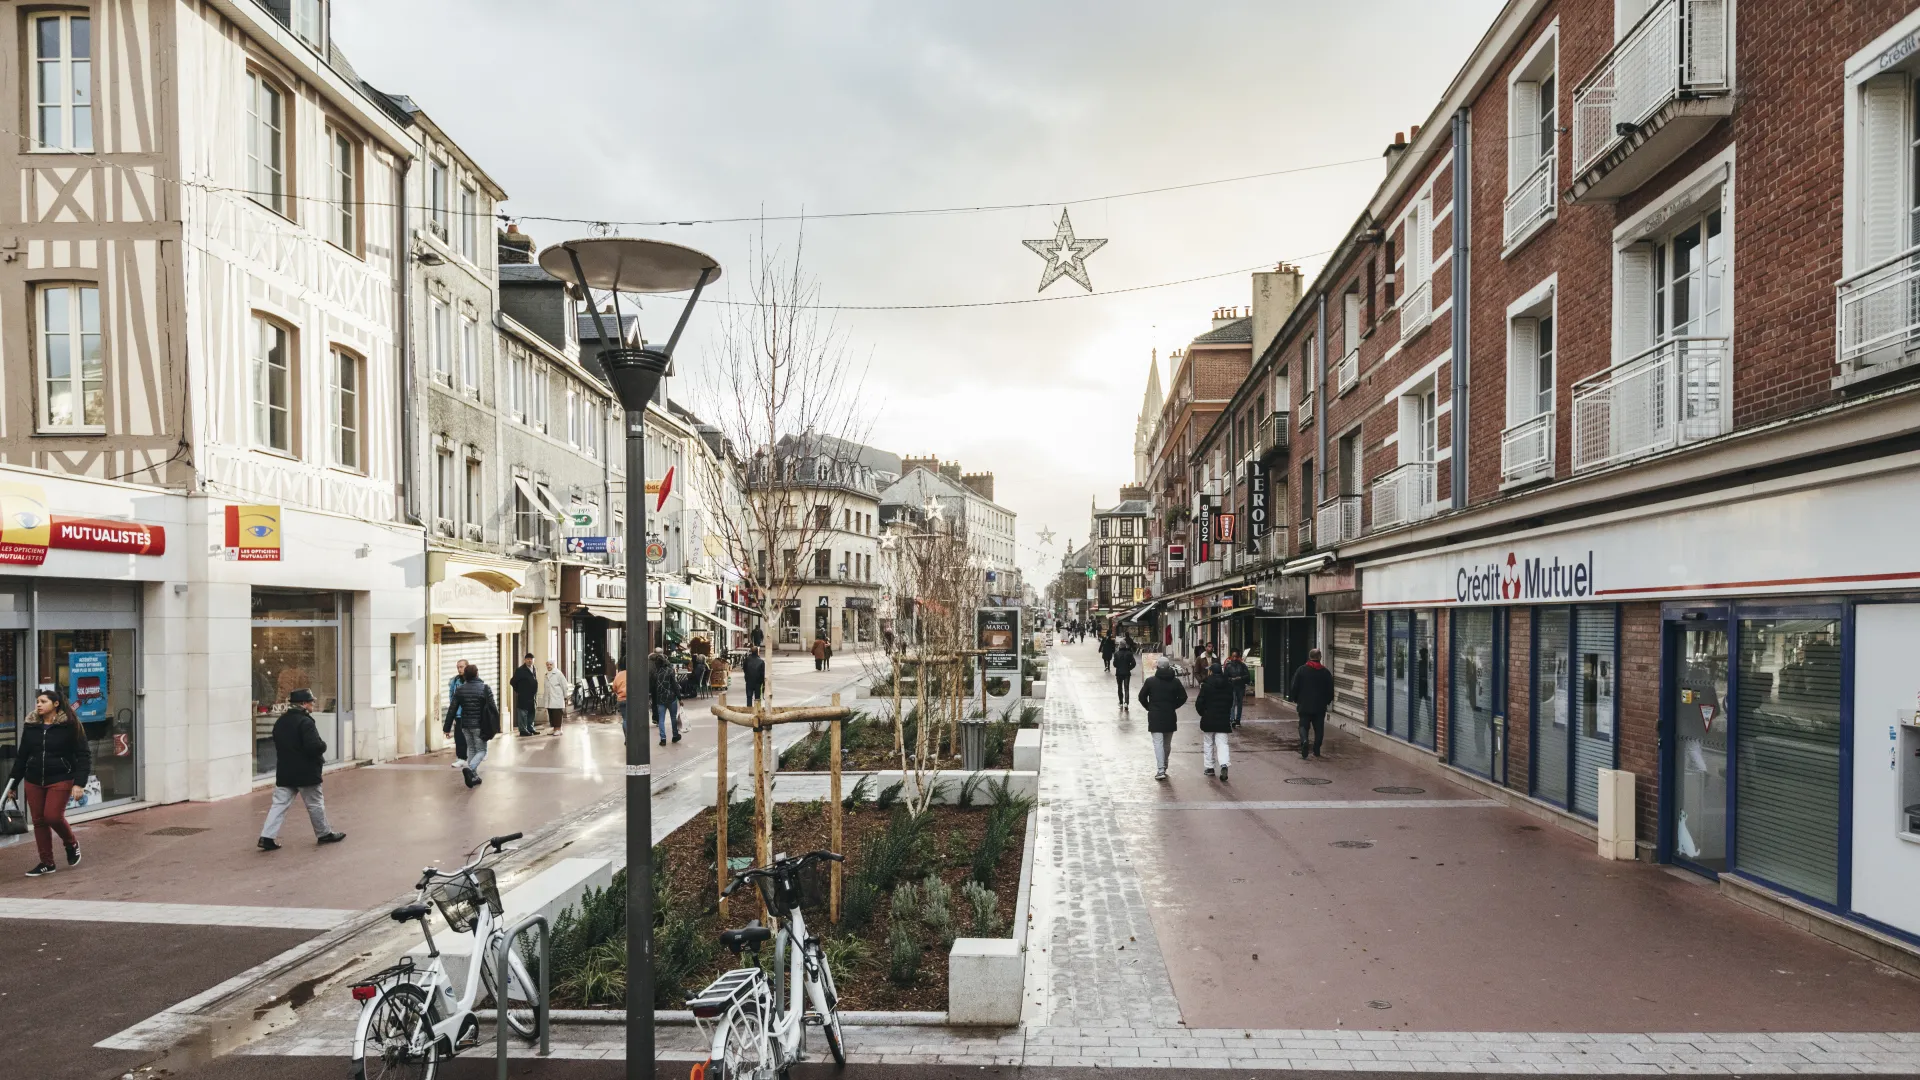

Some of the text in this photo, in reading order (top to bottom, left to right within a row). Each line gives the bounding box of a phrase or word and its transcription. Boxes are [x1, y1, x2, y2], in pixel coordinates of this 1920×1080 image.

[1880, 34, 1916, 68] Crédit
[61, 524, 152, 546] MUTUALISTES
[0, 553, 43, 562] MUTUALISTES
[13, 546, 45, 554] OPTICIENS
[1456, 550, 1593, 603] Crédit Mutuel
